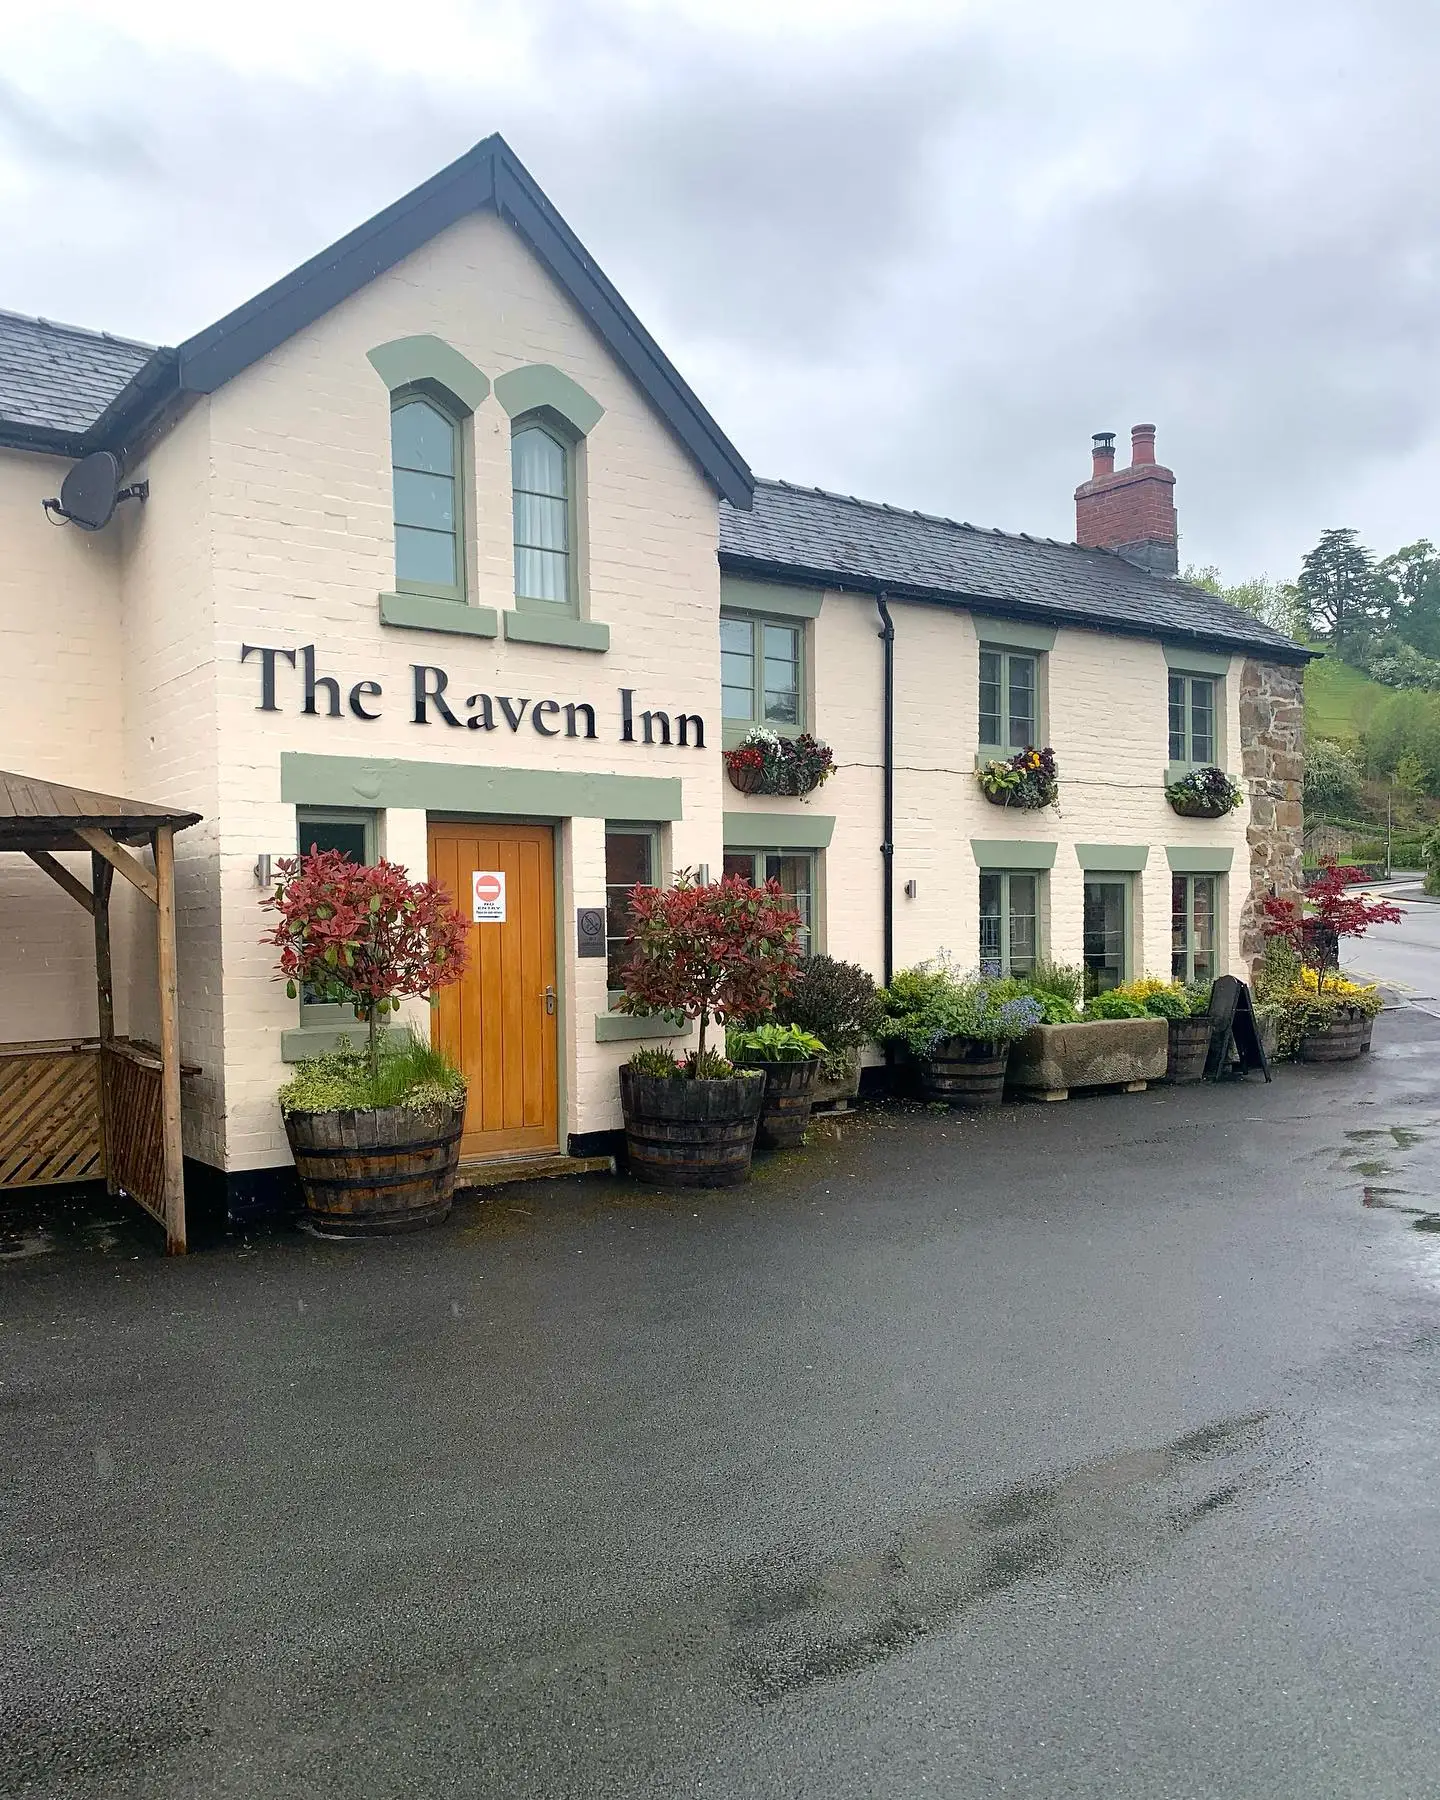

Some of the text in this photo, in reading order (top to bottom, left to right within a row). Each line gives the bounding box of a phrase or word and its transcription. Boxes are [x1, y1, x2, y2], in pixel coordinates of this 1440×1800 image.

[241, 643, 707, 749] The Raven Inn
